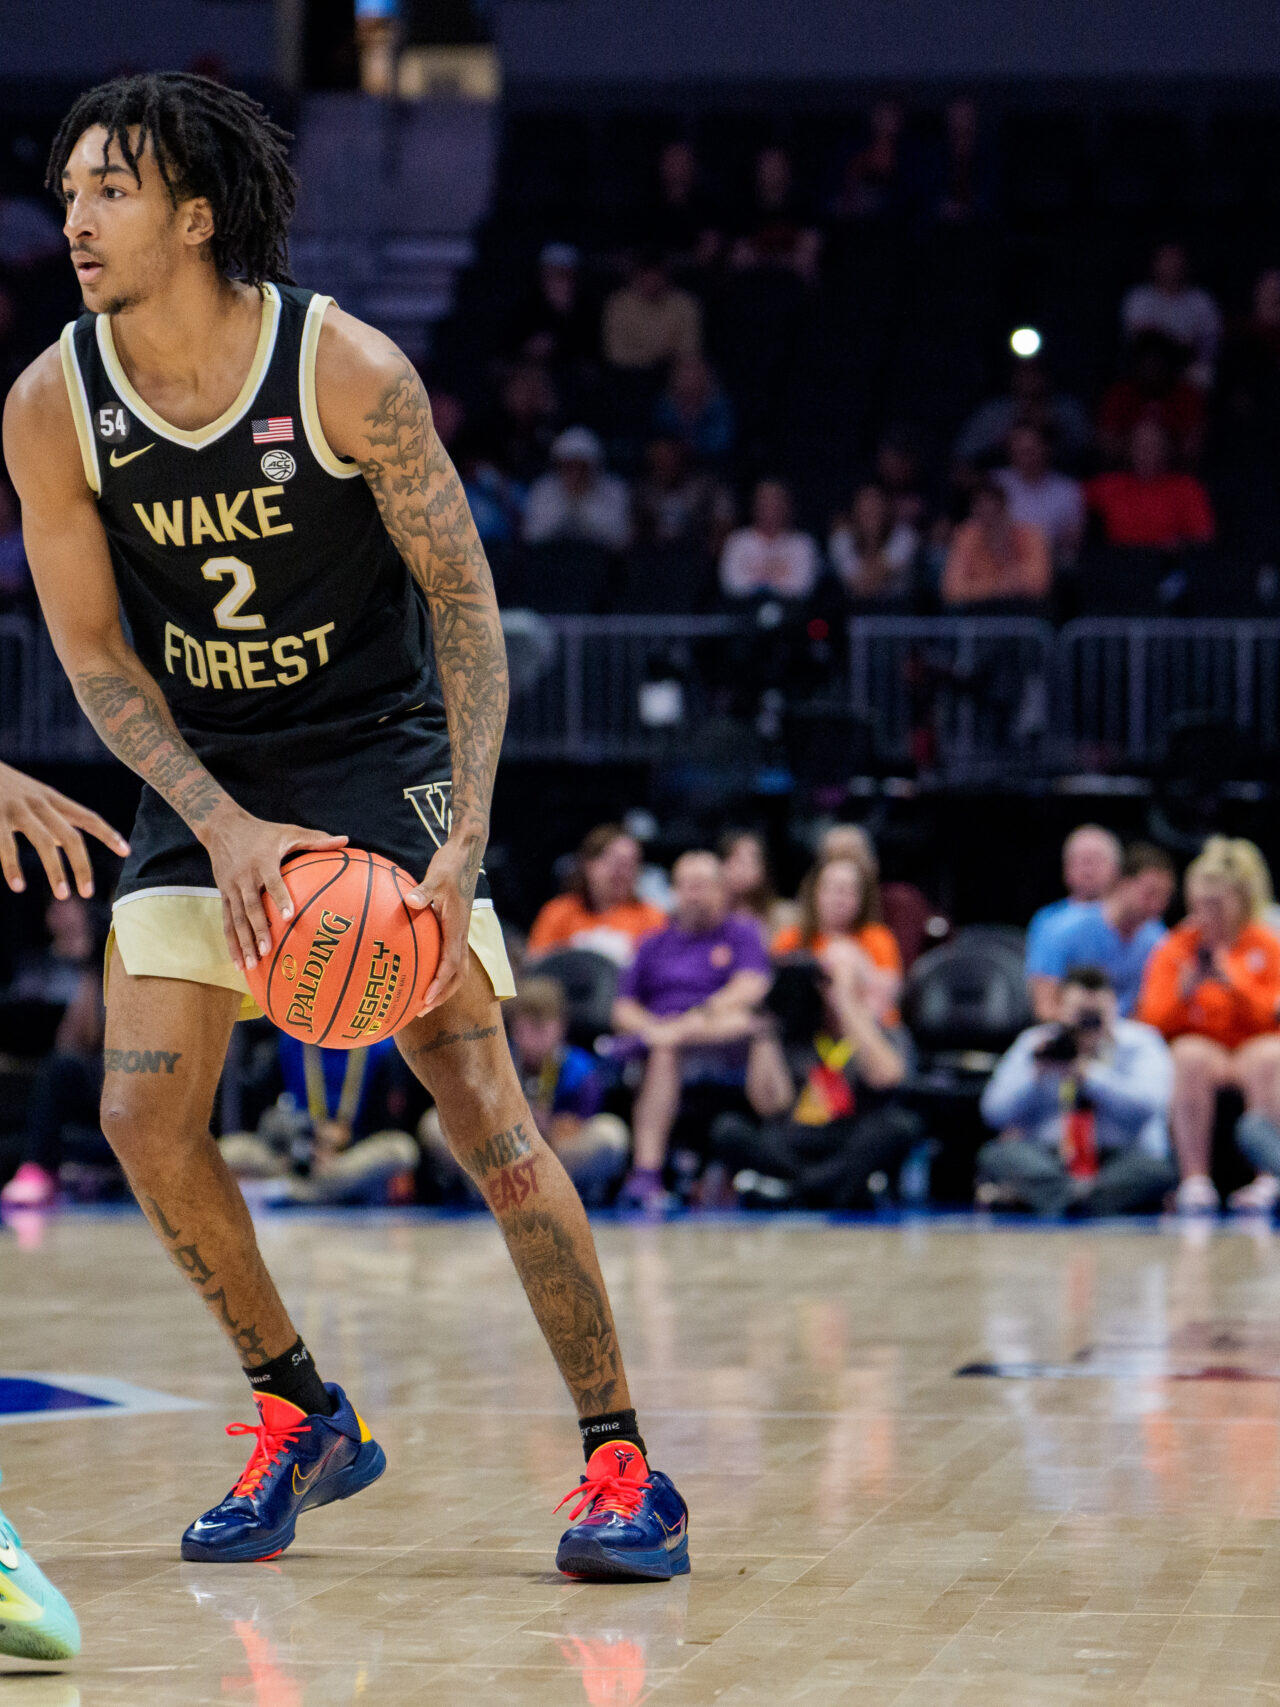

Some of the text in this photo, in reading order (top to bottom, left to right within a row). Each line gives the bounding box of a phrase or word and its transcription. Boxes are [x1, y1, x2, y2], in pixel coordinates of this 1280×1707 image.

[99, 408, 126, 437] 54
[132, 485, 294, 547] WAKE
[201, 556, 266, 631] 2
[165, 621, 335, 690] FOREST
[285, 909, 354, 1033] SPALDING
[341, 940, 390, 1039] LEGACY
